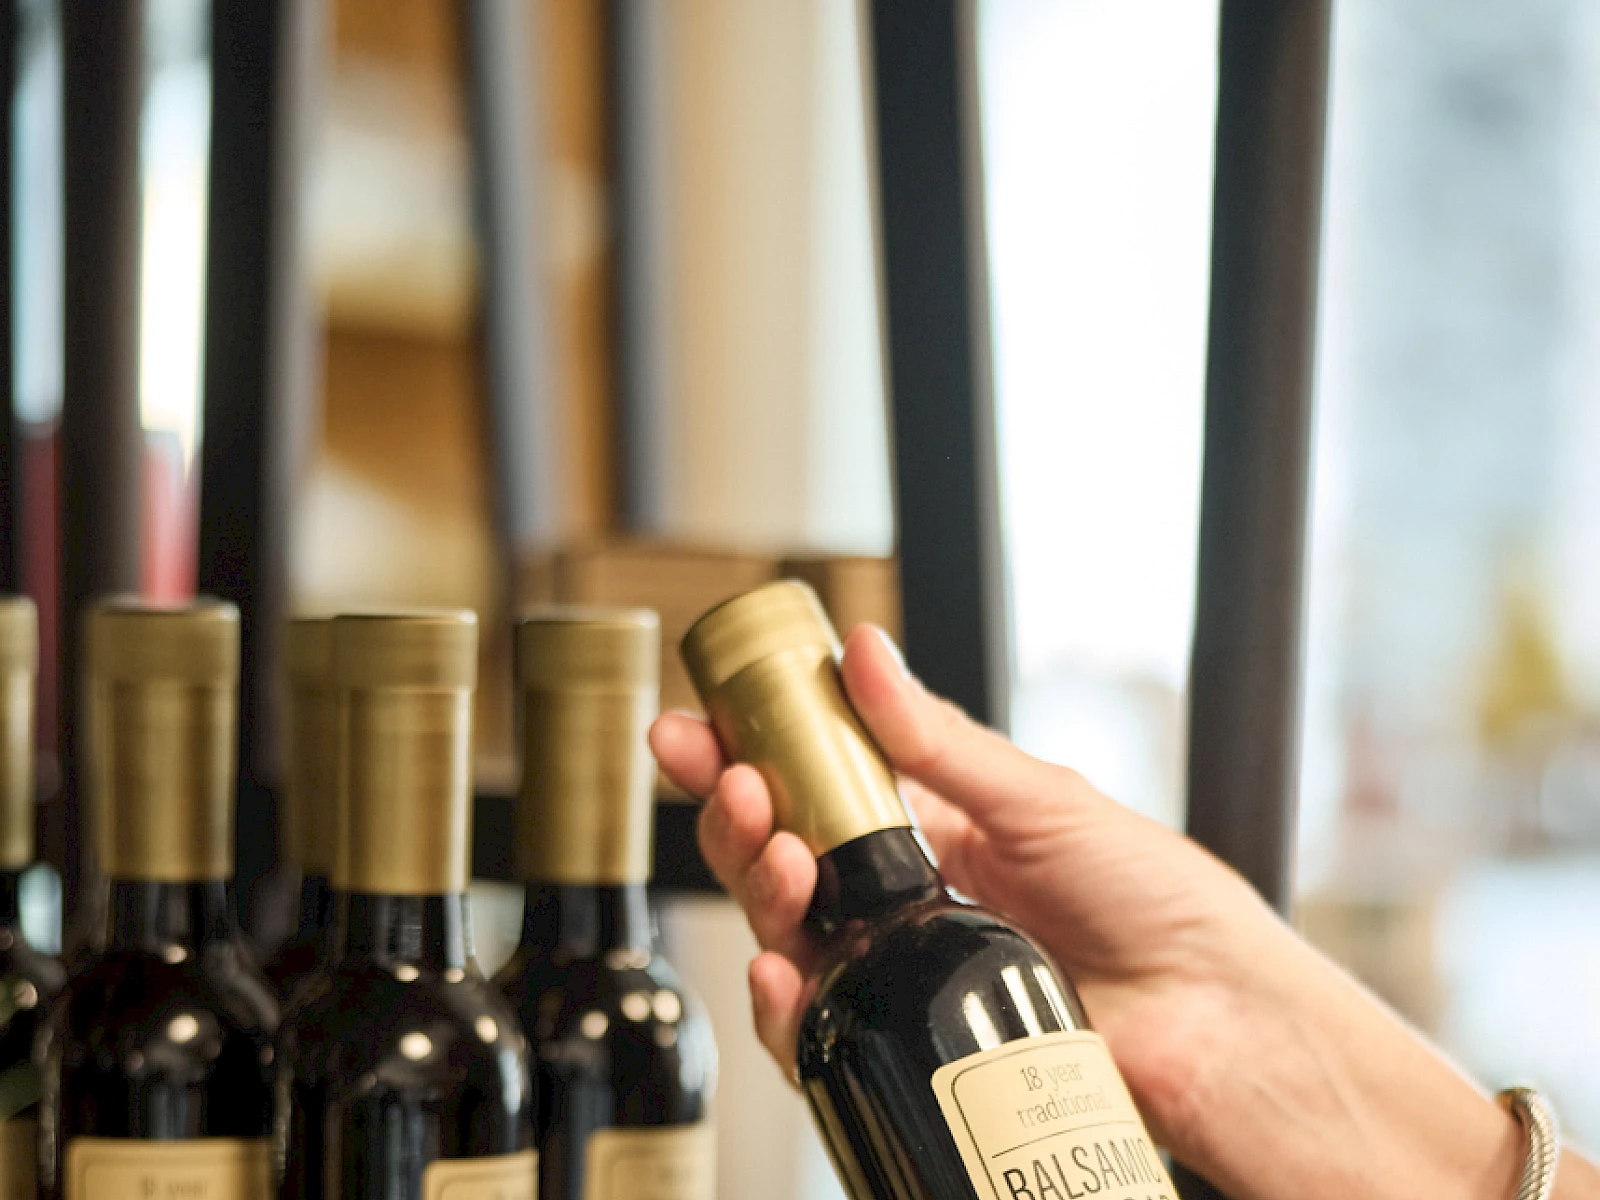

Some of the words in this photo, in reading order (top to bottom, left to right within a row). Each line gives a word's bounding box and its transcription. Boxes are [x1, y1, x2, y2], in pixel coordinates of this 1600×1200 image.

[1020, 1065, 1043, 1091] 18
[1045, 1062, 1084, 1091] year
[1016, 1085, 1112, 1128] traditional
